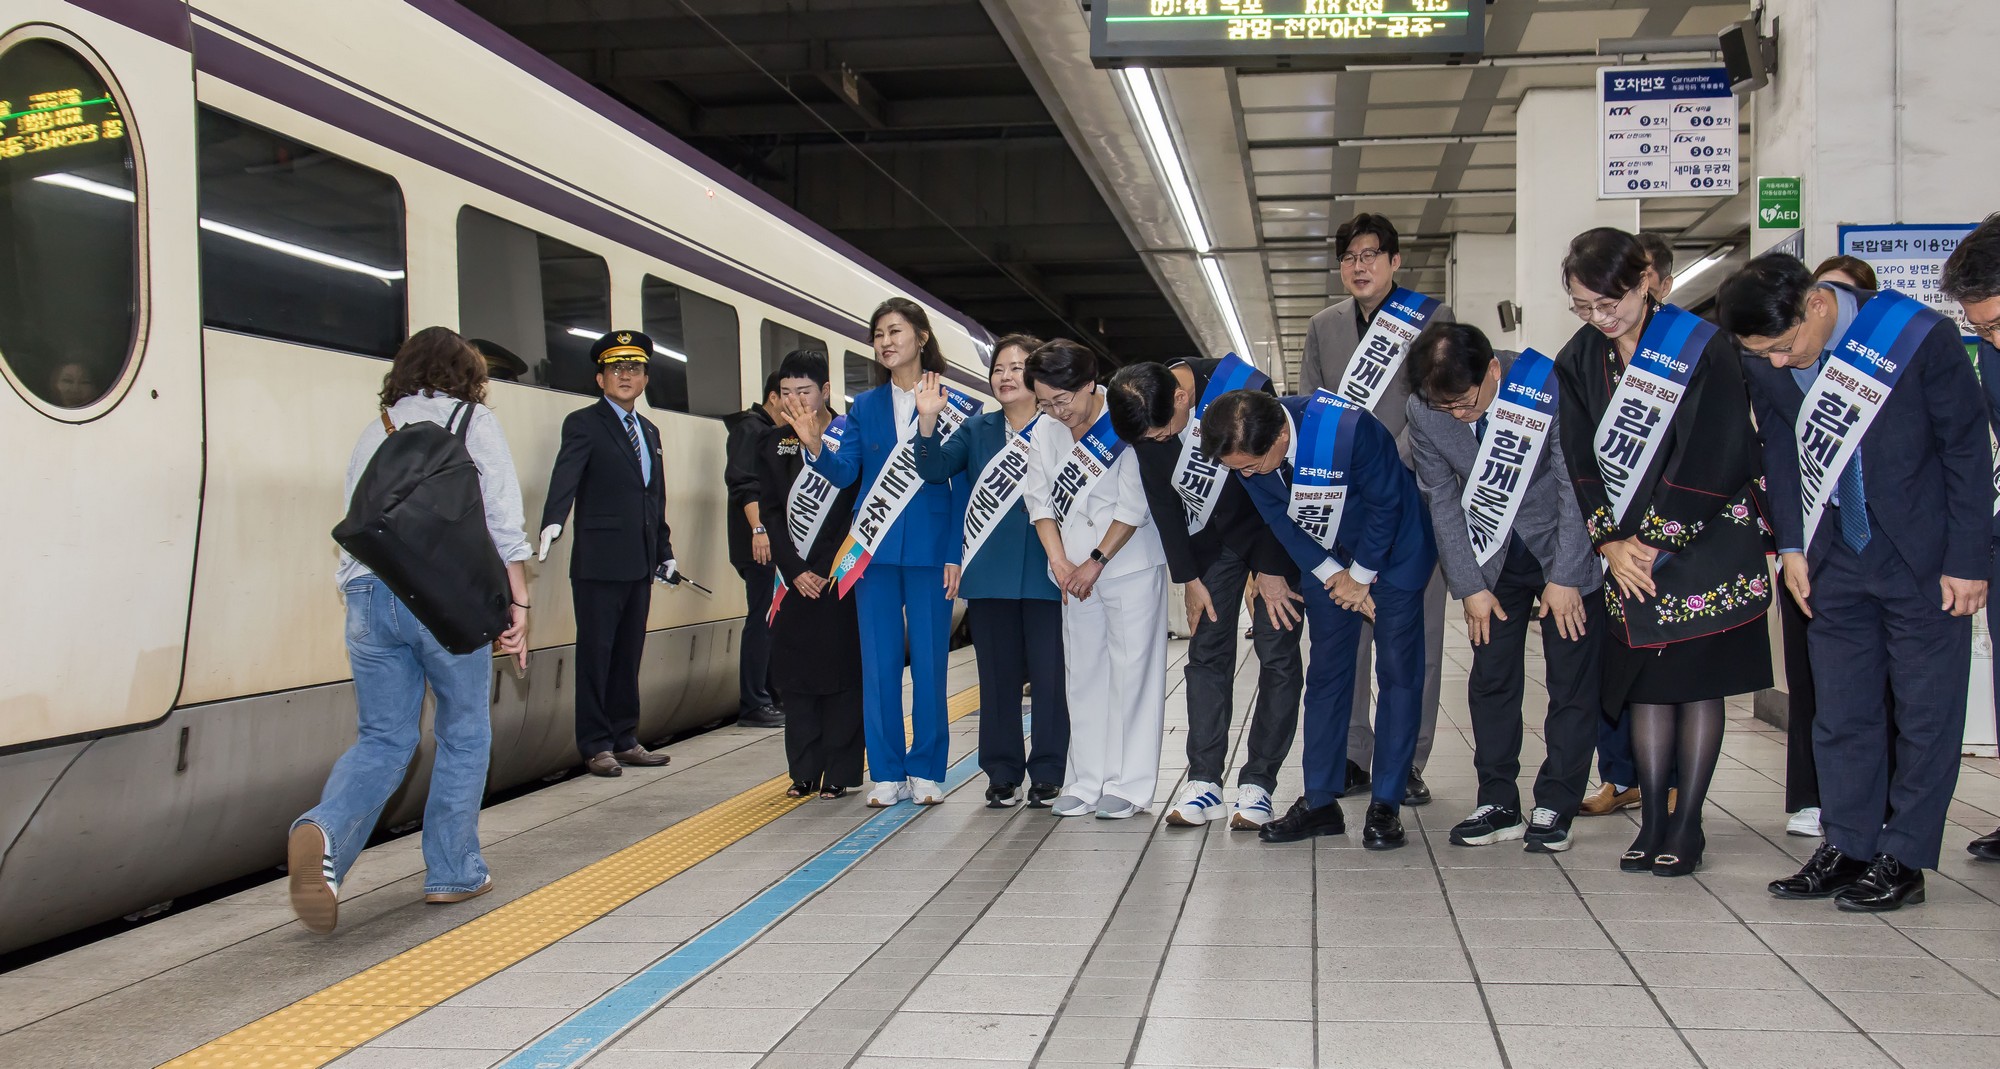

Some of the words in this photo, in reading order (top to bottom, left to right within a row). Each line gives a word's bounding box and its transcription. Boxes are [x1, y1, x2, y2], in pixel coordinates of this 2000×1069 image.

[1614, 77, 1666, 92] 호차번호
[1683, 75, 1710, 83] number
[1609, 105, 1637, 116] KTX
[1653, 117, 1668, 126] 호차
[1716, 117, 1731, 126] 호차
[1653, 145, 1668, 153] 호차
[1716, 147, 1731, 156] 호차
[1674, 165, 1700, 175] 새마을
[1704, 164, 1730, 174] 무궁화
[1653, 181, 1668, 189] 호차
[1716, 179, 1731, 188] 호차
[1776, 210, 1799, 220] AED
[1851, 239, 1909, 253] 복합열차
[1876, 265, 1904, 274] EXPO
[1910, 264, 1940, 275] 방면은
[1923, 293, 1954, 304] 바랍니
[1390, 301, 1425, 321] 조국혁신당
[1640, 348, 1689, 374] 조국혁신당
[1845, 339, 1897, 374] 조국혁신당
[1624, 374, 1655, 396] 행복할
[1655, 386, 1679, 404] 권리
[1824, 366, 1858, 392] 행복할
[1857, 384, 1883, 405] 권리
[1507, 382, 1553, 403] 조국혁신당
[947, 390, 974, 411] 국혁신당
[1495, 407, 1526, 426] 행복할
[1525, 417, 1546, 432] 권리
[1086, 433, 1114, 461] 조국혁신당
[1299, 467, 1344, 479] 조국혁신당
